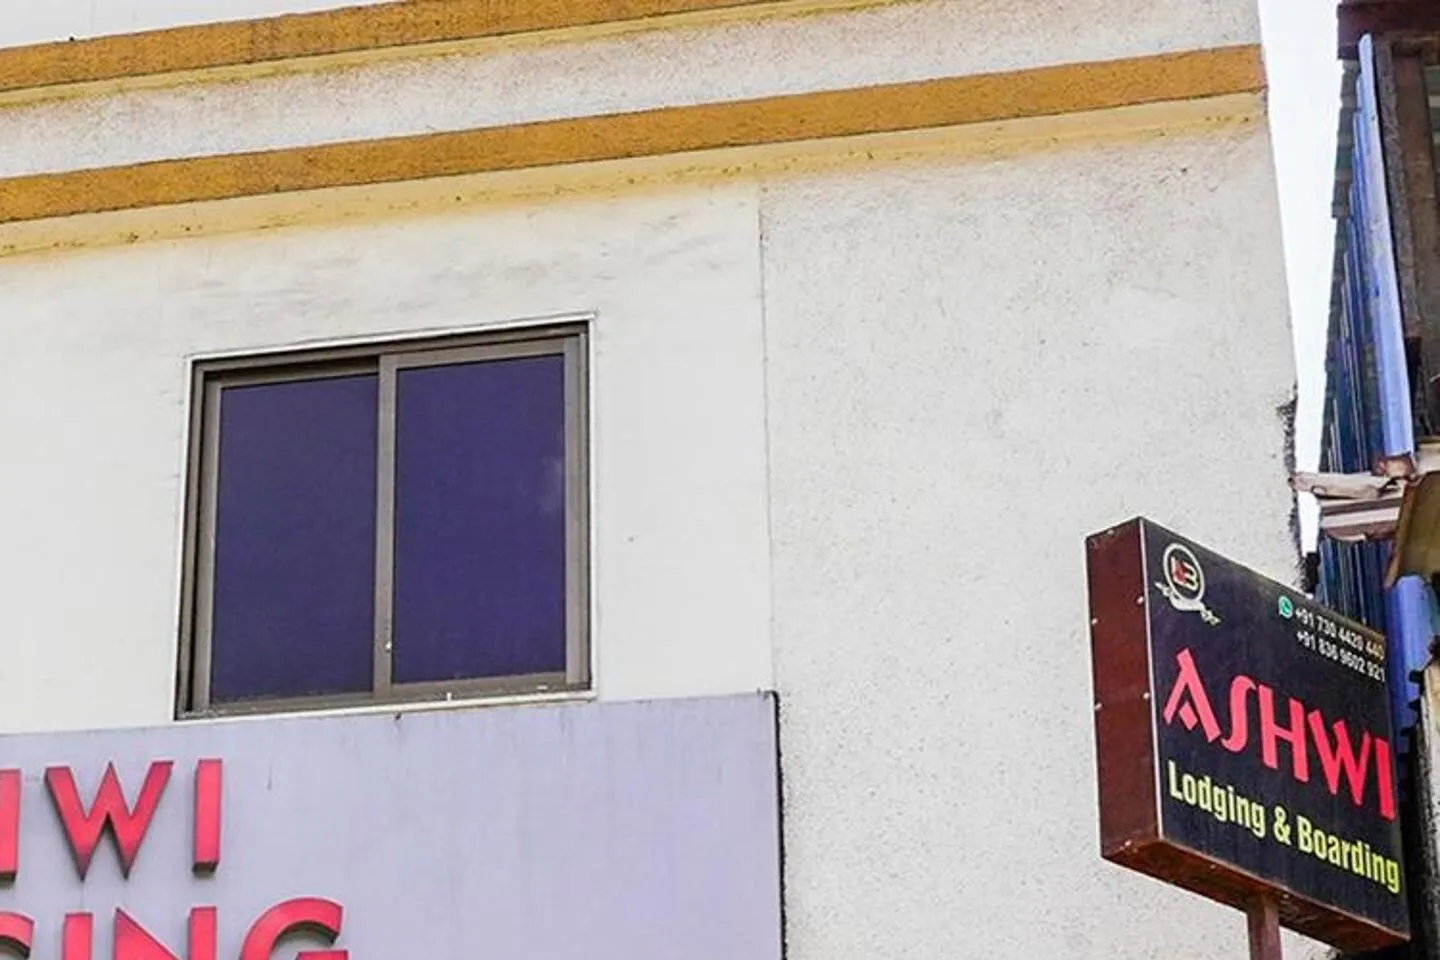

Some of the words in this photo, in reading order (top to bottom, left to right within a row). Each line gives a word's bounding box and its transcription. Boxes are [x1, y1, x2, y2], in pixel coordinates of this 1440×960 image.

[1296, 608, 1314, 628] +91
[1297, 631, 1315, 651] +91
[1163, 647, 1397, 822] ASHWI
[1168, 760, 1266, 840] Lodging
[1273, 807, 1292, 847] &
[1297, 815, 1401, 894] Boarding
